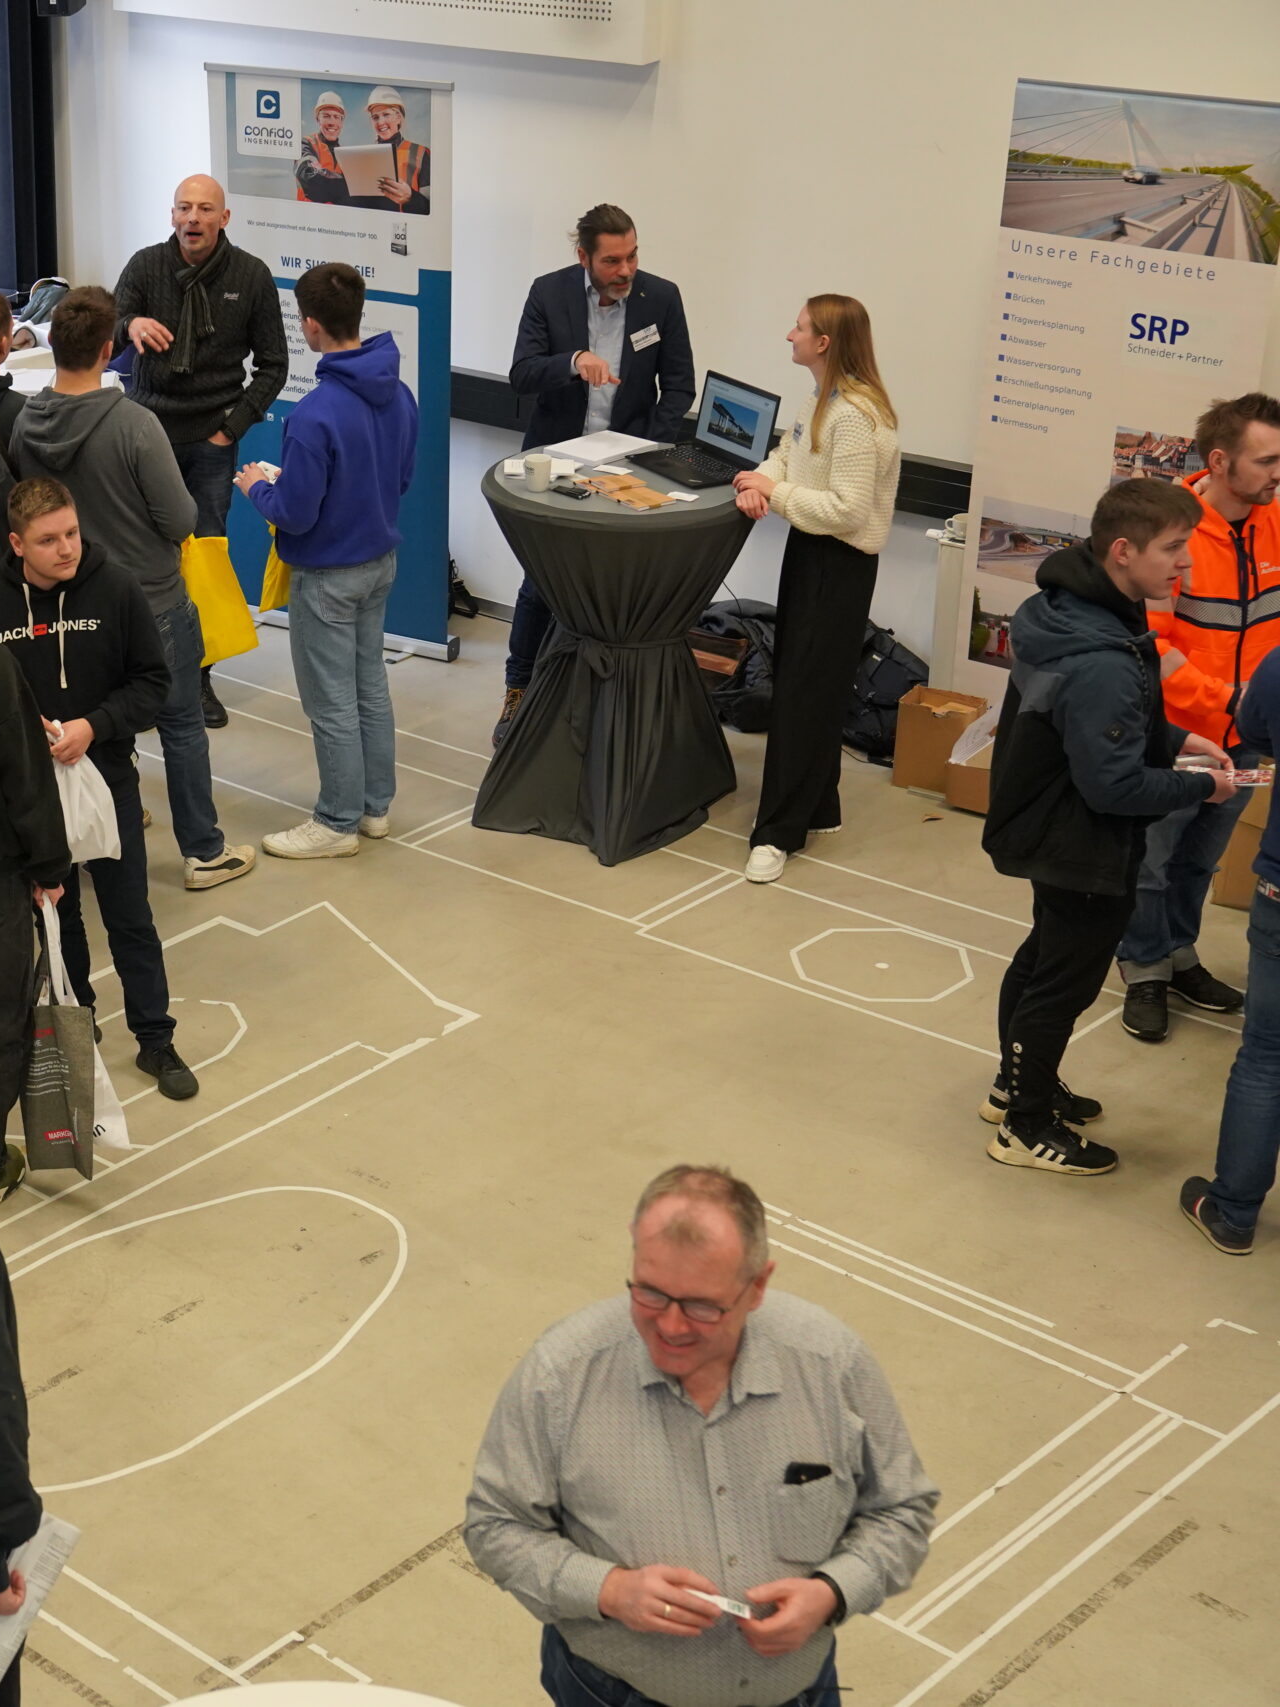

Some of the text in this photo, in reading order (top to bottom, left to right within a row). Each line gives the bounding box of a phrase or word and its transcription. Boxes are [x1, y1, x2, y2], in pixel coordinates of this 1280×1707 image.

[245, 125, 293, 139] confido
[245, 137, 293, 147] INGENIEURE
[280, 255, 302, 270] WIR
[1010, 239, 1216, 281] Unsere Fachgebiete
[1015, 271, 1073, 288] Verkehrswege
[1012, 293, 1045, 305] Brücken
[1010, 314, 1085, 334] Tragwerksplanung
[1129, 313, 1190, 345] SRP
[1008, 335, 1047, 348] Abwasser
[1127, 343, 1175, 359] Schneider
[1185, 352, 1224, 367] Partner
[1006, 355, 1081, 376] Wasserversorgung
[289, 374, 314, 384] Melden
[1003, 375, 1092, 399] Erschließungsplanung
[1001, 396, 1075, 416] Generalplanungen
[999, 416, 1049, 433] Vermessung
